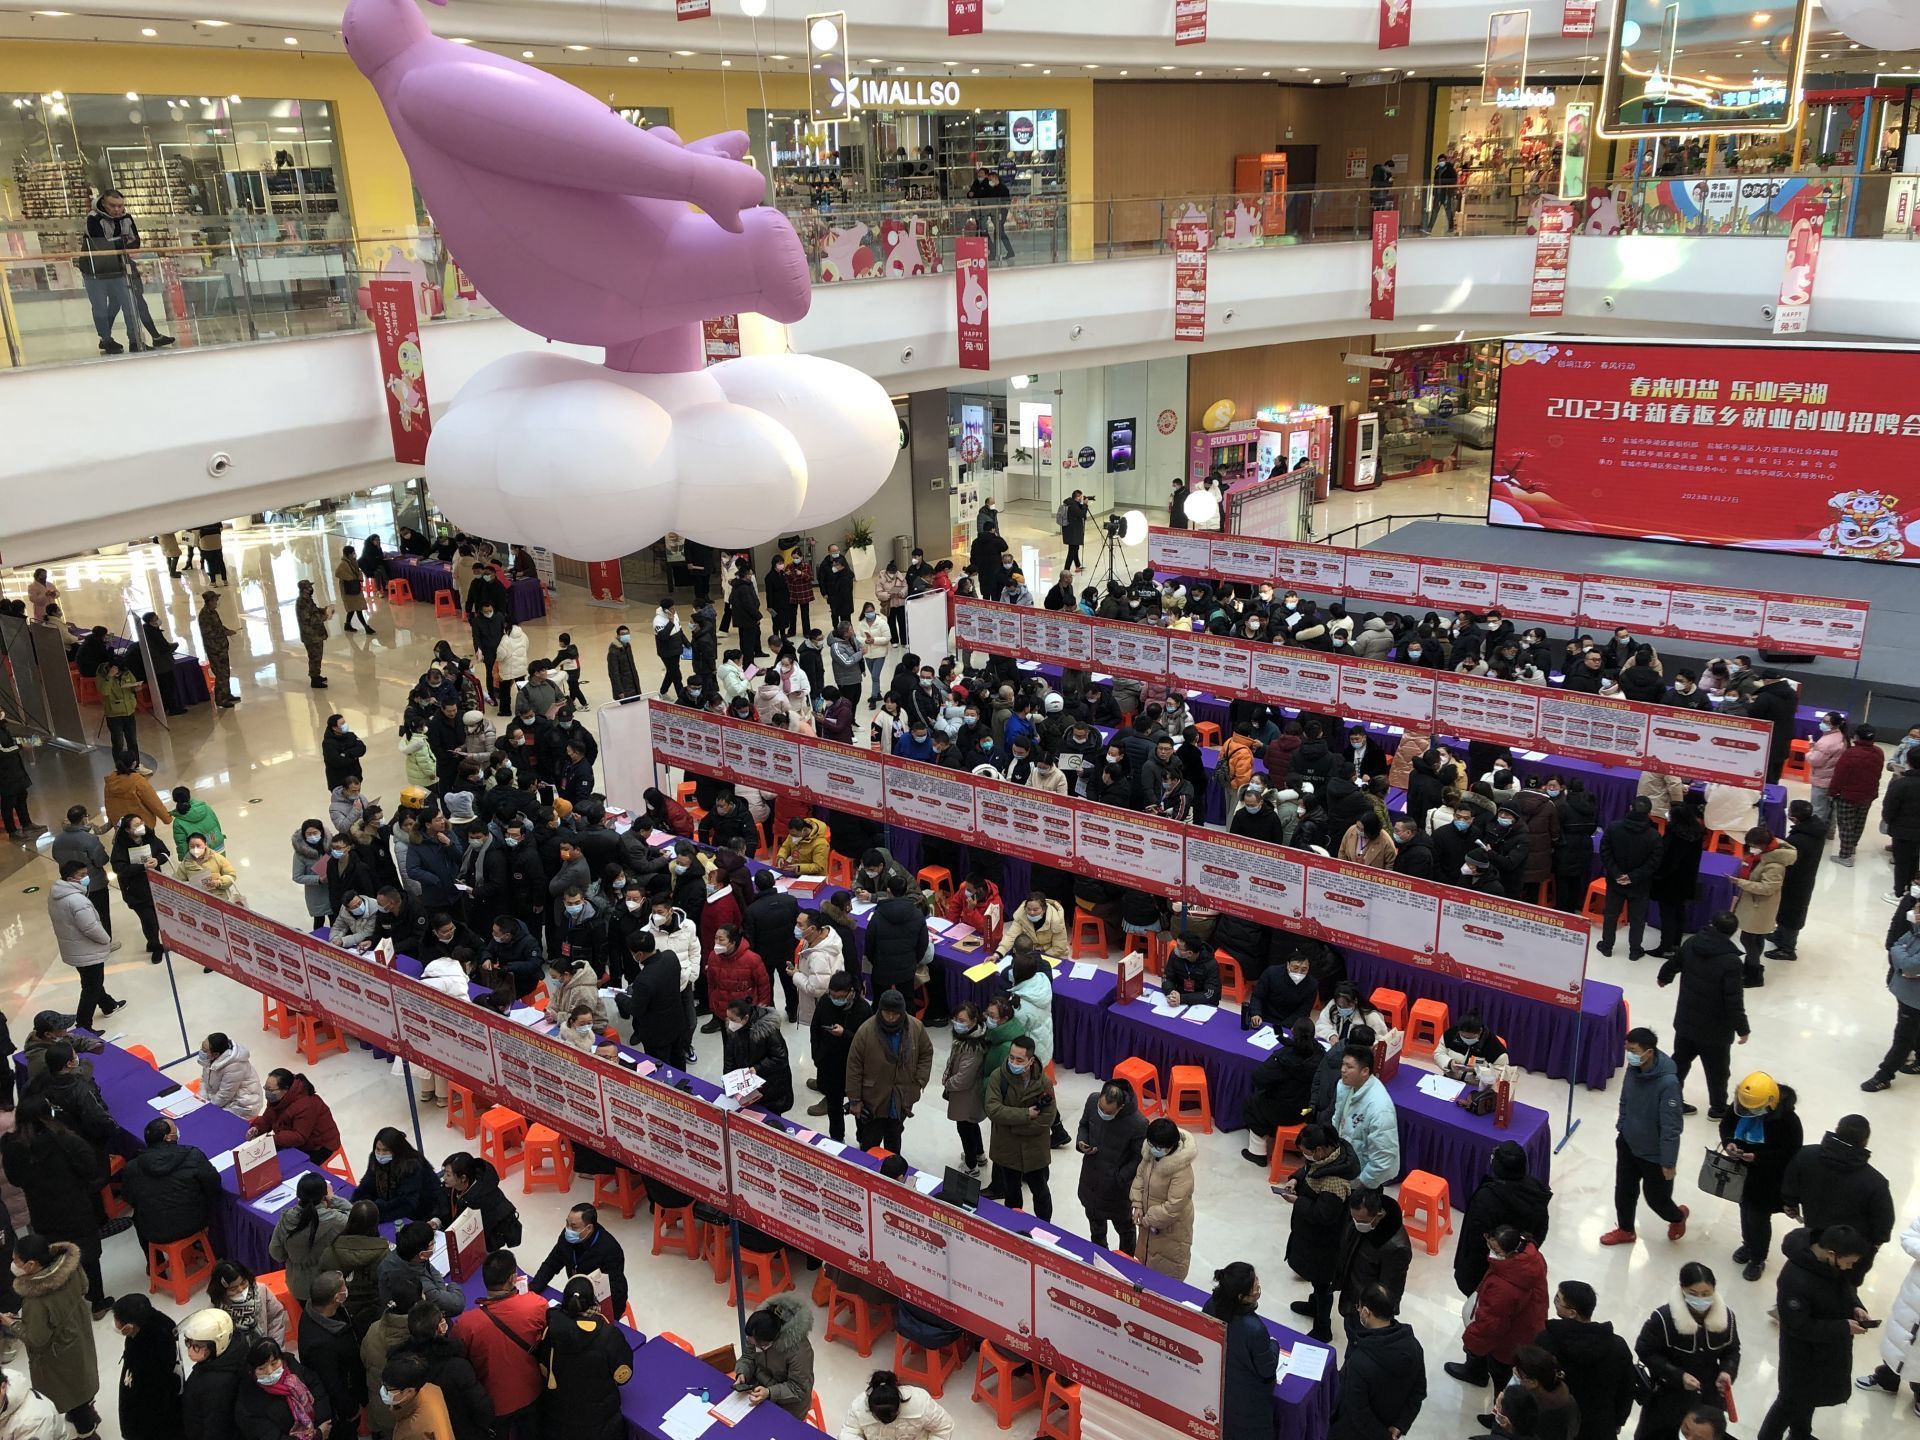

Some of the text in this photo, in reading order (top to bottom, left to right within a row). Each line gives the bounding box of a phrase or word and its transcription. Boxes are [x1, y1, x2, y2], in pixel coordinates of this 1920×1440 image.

[862, 80, 960, 105] IMALLSO
[963, 330, 984, 338] HAPPY
[1600, 361, 1636, 370] 春风行动
[1630, 376, 1830, 406] 春来归盐 乐业亭湖
[1547, 398, 1920, 438] 2023年新春返乡就业创业招聘会
[1210, 430, 1258, 446] SUPER IDOL
[1600, 436, 1839, 457] 主办 盐城市亭湖区委组织部 盐城市亭湖区人力资源和社会保障局
[1599, 458, 1835, 481] 承办 盐城市亭湖区劳动就业服务中心 盐城市亭湖区人才服务中心
[1681, 493, 1739, 504] 2023年1月27日
[1308, 929, 1318, 937] 50
[1440, 964, 1450, 973] 51
[737, 1209, 747, 1219] 61
[897, 1220, 919, 1236] 服务员
[921, 1231, 931, 1241] 3人
[877, 1276, 889, 1288] 62
[1069, 1298, 1098, 1318] 前台 2人
[1143, 1331, 1181, 1355] 服务员 6人
[1039, 1353, 1053, 1366] 63
